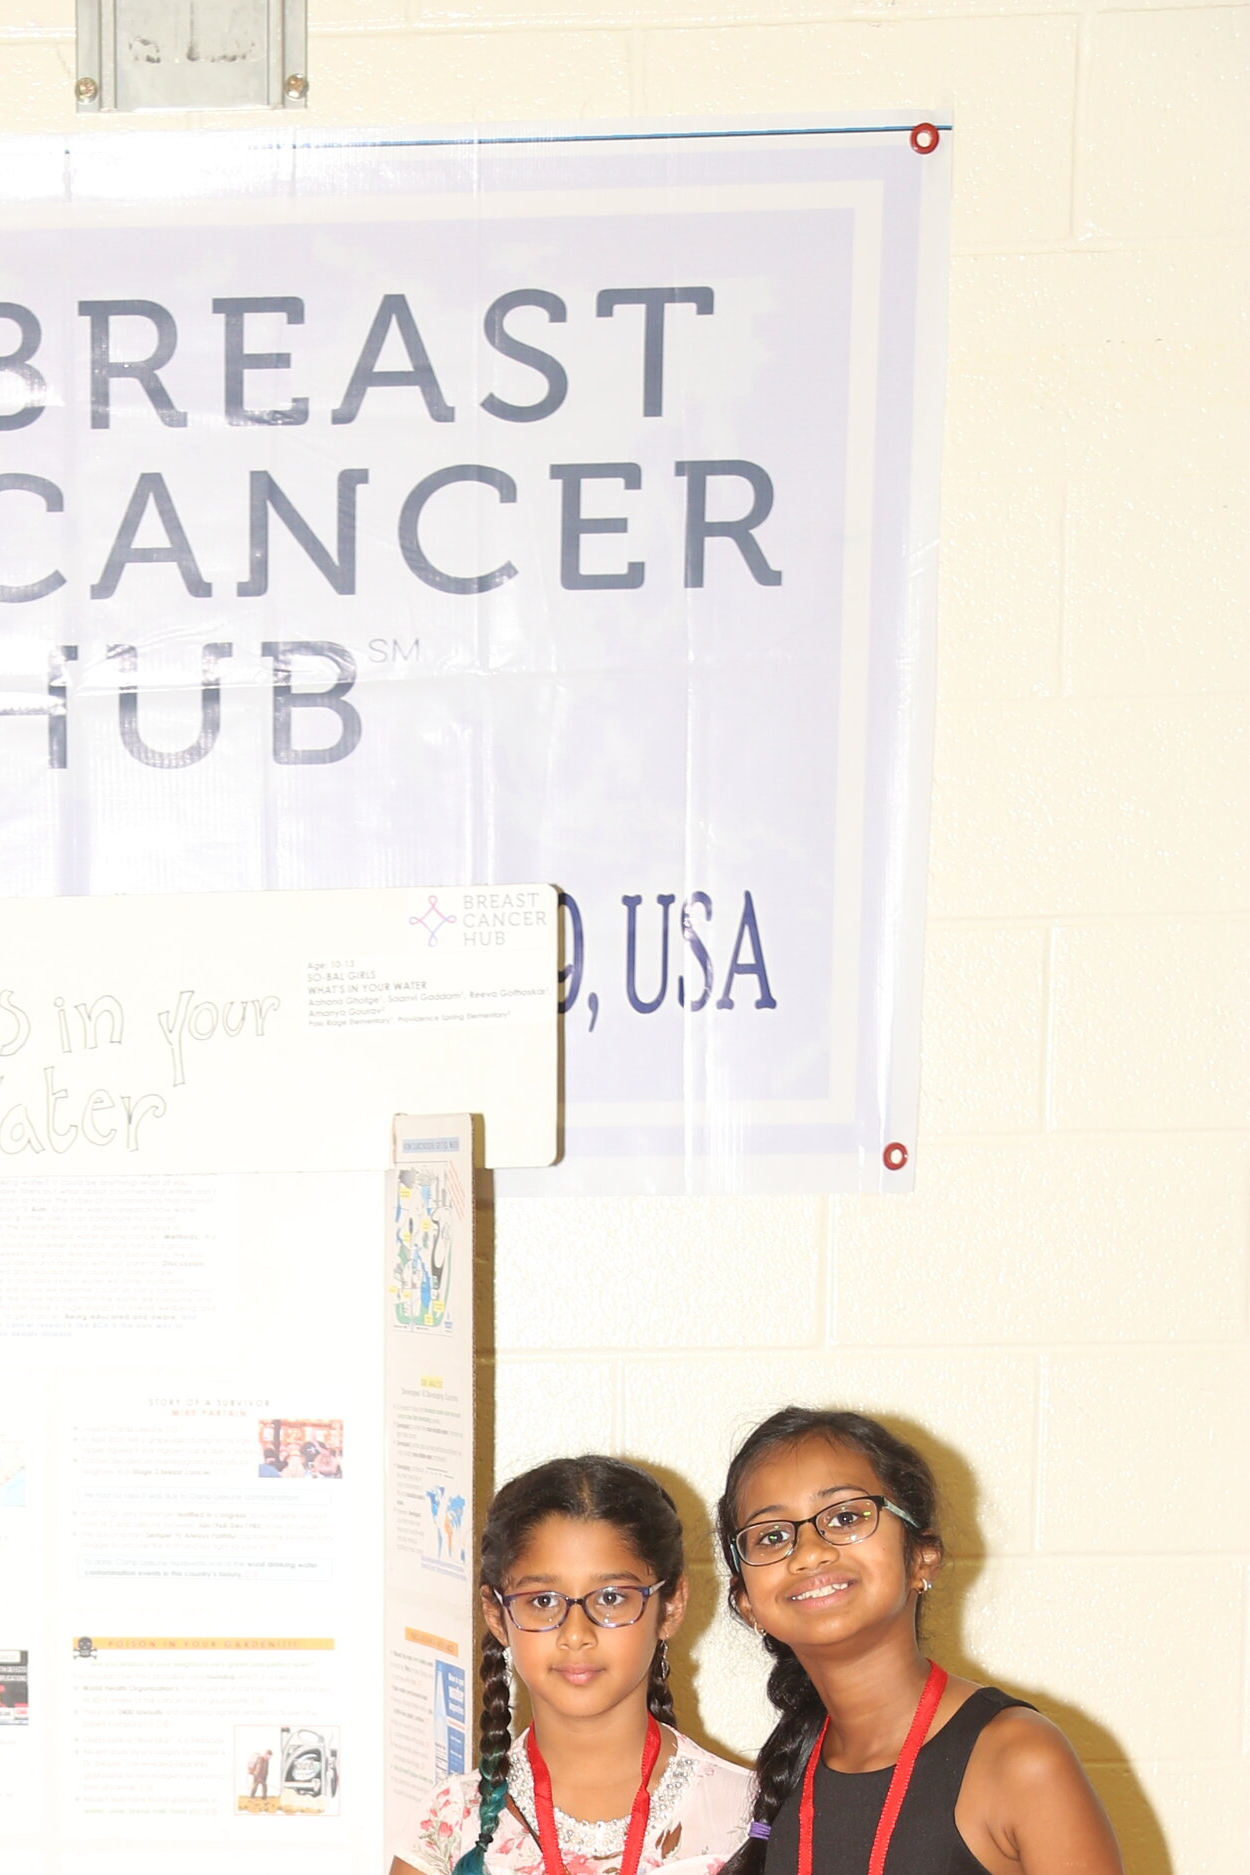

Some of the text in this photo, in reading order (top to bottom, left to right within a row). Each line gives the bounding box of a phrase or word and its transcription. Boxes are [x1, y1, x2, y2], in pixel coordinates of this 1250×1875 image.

[463, 893, 539, 910] BREAST
[463, 911, 548, 929] CANCER
[463, 931, 506, 947] HUB
[622, 890, 778, 1015] USA
[348, 971, 376, 980] GIRLS
[308, 981, 427, 995] WHAT'S IN YOUR WATER
[53, 997, 125, 1053] in
[157, 990, 282, 1088] your
[216, 1399, 271, 1408] SURVIVOR
[108, 1639, 157, 1648] POISON
[163, 1639, 176, 1648] IN
[183, 1639, 217, 1648] YOUR
